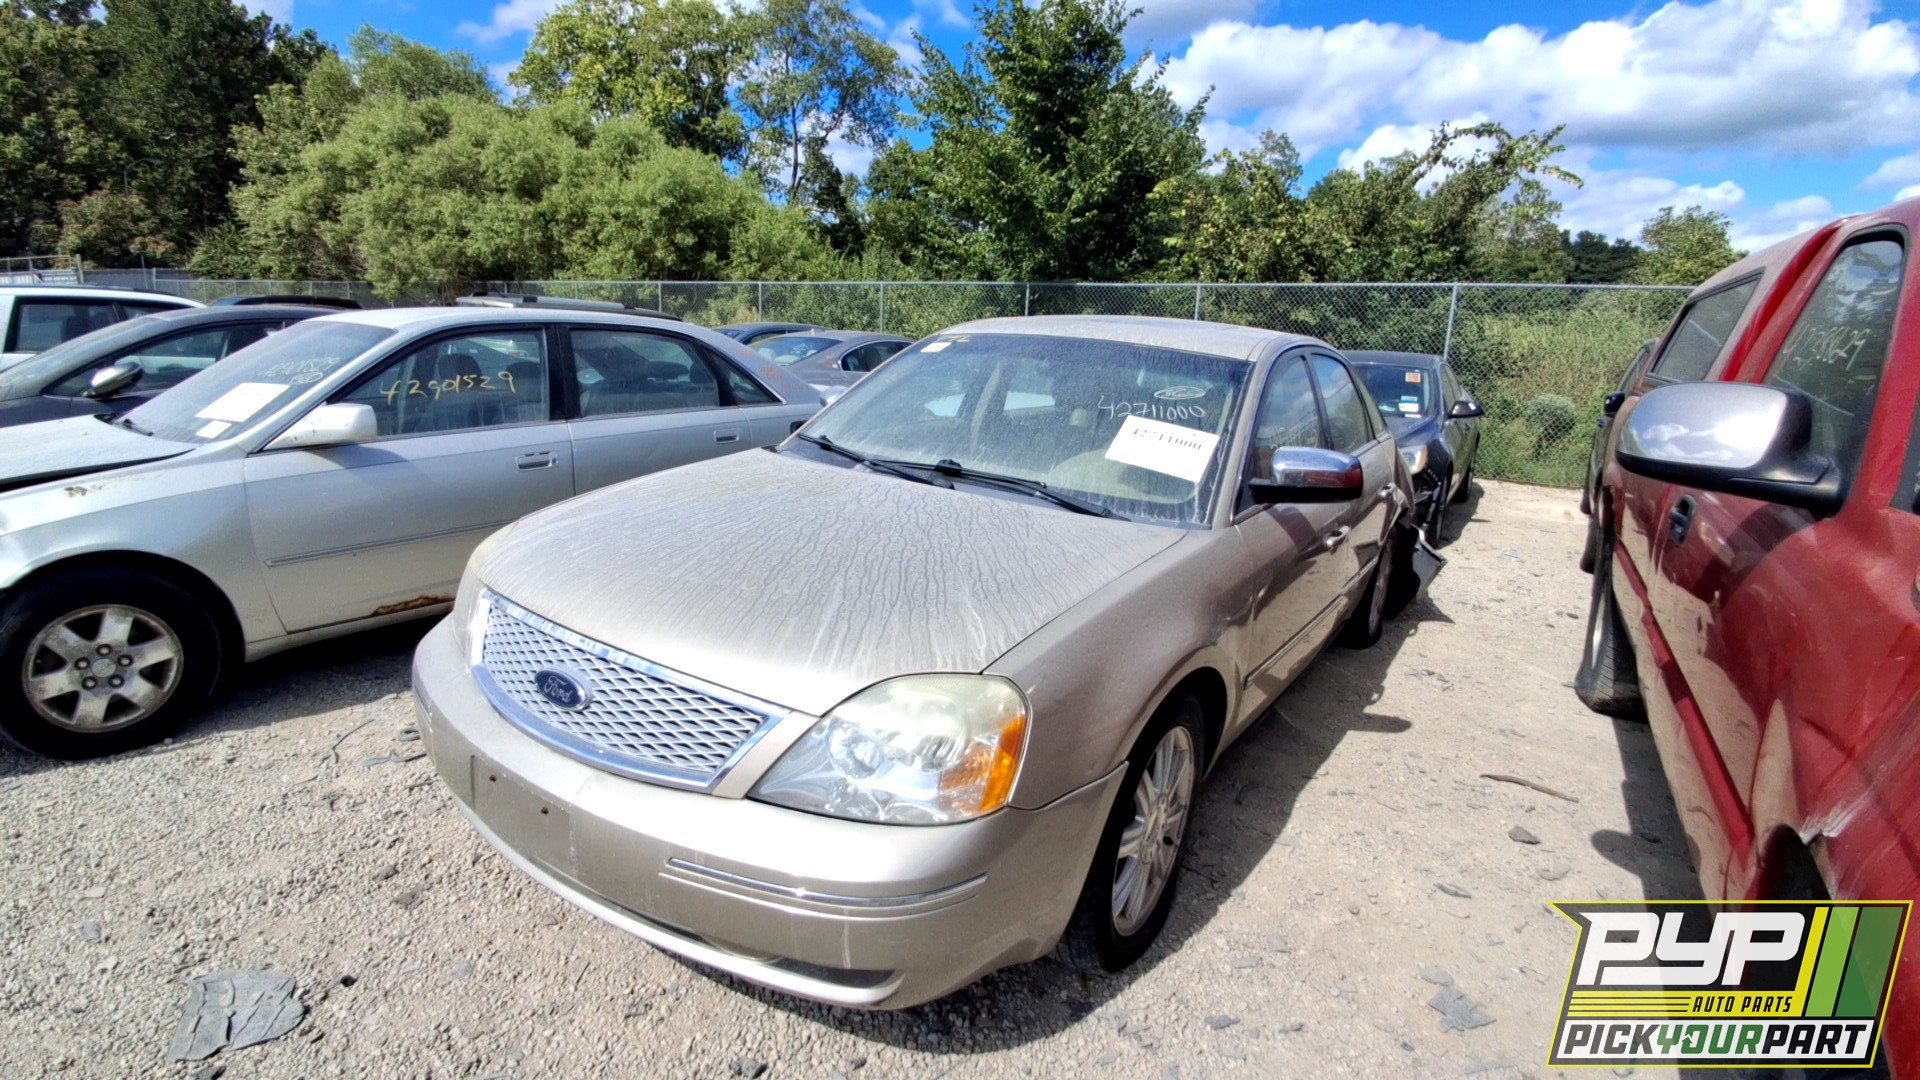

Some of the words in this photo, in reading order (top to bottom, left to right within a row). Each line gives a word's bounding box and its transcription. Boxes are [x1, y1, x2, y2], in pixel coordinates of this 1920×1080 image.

[379, 371, 516, 405] 42901529
[1097, 395, 1206, 421] 42711000
[543, 675, 574, 703] Ford
